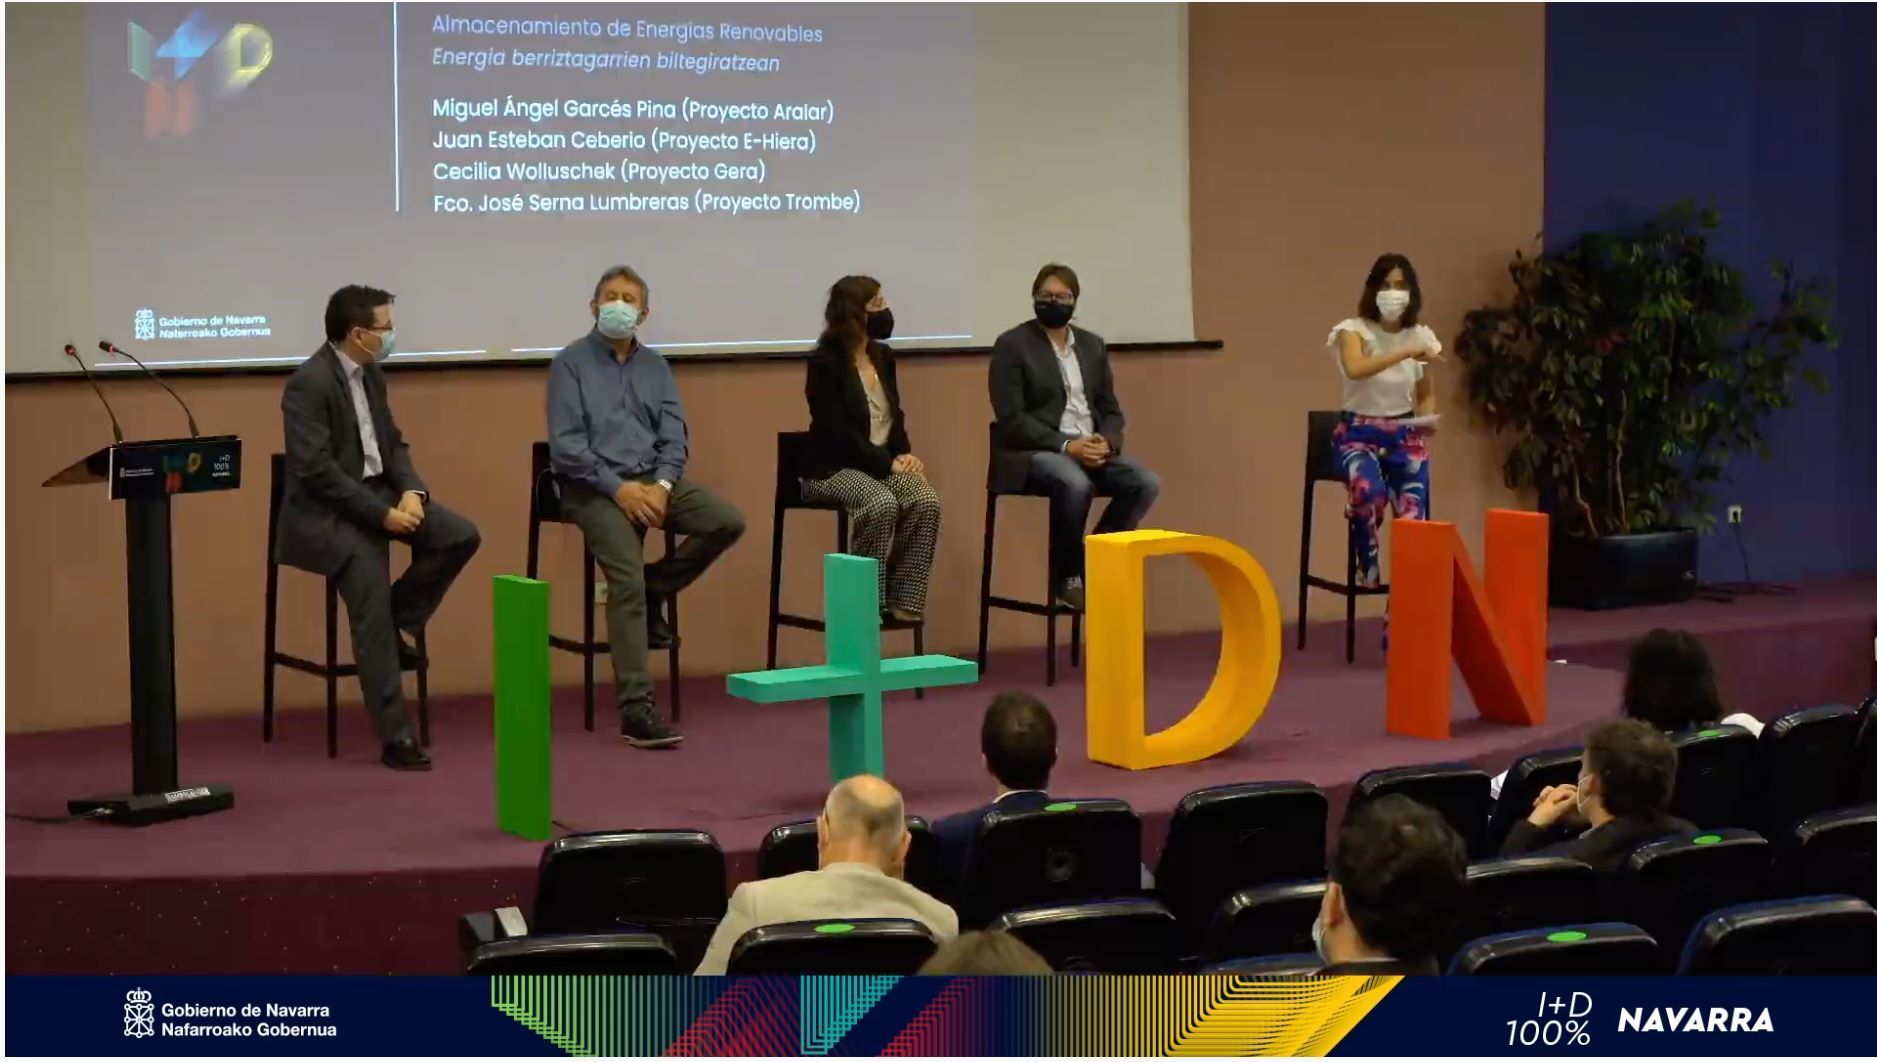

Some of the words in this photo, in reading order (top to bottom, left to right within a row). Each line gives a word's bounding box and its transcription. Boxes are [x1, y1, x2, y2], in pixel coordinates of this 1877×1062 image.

[432, 14, 601, 36] Almacenamiento
[607, 18, 631, 37] de
[720, 22, 823, 42] Renovables
[512, 48, 650, 72] berriztagarrien
[657, 50, 779, 74] biltegiratzean
[432, 97, 498, 122] Miguel
[503, 95, 558, 122] Ángel
[564, 99, 632, 118] Garcés
[637, 100, 676, 119] Pina
[682, 97, 768, 124] (Proyecto
[773, 99, 833, 124] Aralar)
[432, 130, 482, 149] Juan
[488, 130, 566, 149] Esteban
[571, 130, 645, 149] Ceberio
[651, 126, 738, 154] (Proyecto
[744, 128, 816, 154] E-Hiera)
[433, 160, 501, 180] Cecilia
[506, 161, 615, 180] Wolluschek
[621, 158, 709, 184] (Proyecto
[714, 158, 765, 184] Gera)
[434, 194, 473, 212] Fco.
[479, 193, 523, 212] José
[529, 193, 584, 211] Serna
[590, 193, 689, 211] Lumbreras
[695, 188, 780, 215] (Proyecto
[785, 188, 860, 214] Trombe)
[210, 315, 223, 326] de
